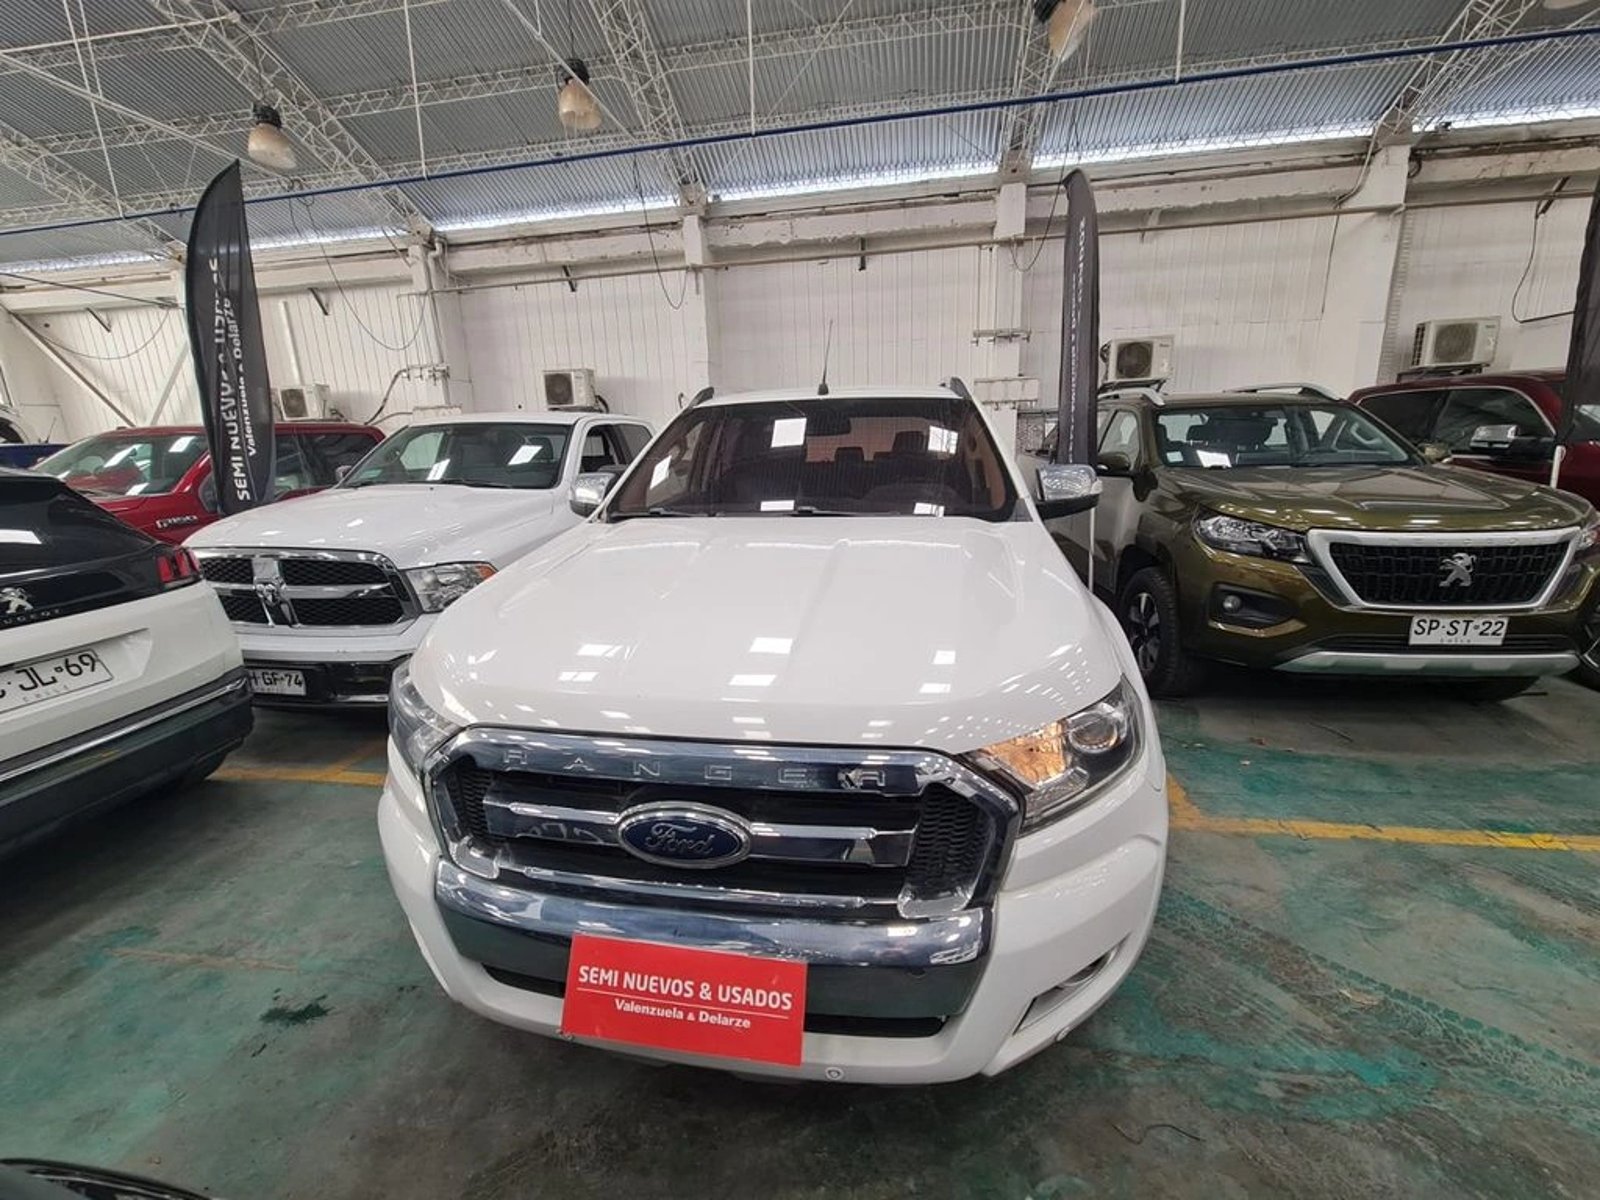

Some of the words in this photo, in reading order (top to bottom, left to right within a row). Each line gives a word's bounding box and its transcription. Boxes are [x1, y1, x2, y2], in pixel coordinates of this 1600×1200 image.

[230, 455, 251, 501] SEMI
[645, 822, 716, 856] Ford
[578, 965, 618, 987] SEMI
[623, 972, 694, 998] NUEVOS
[699, 982, 712, 1001] &
[718, 984, 793, 1010] USADOS
[615, 998, 684, 1020] Valenzuela
[699, 1011, 751, 1029] Delarze
